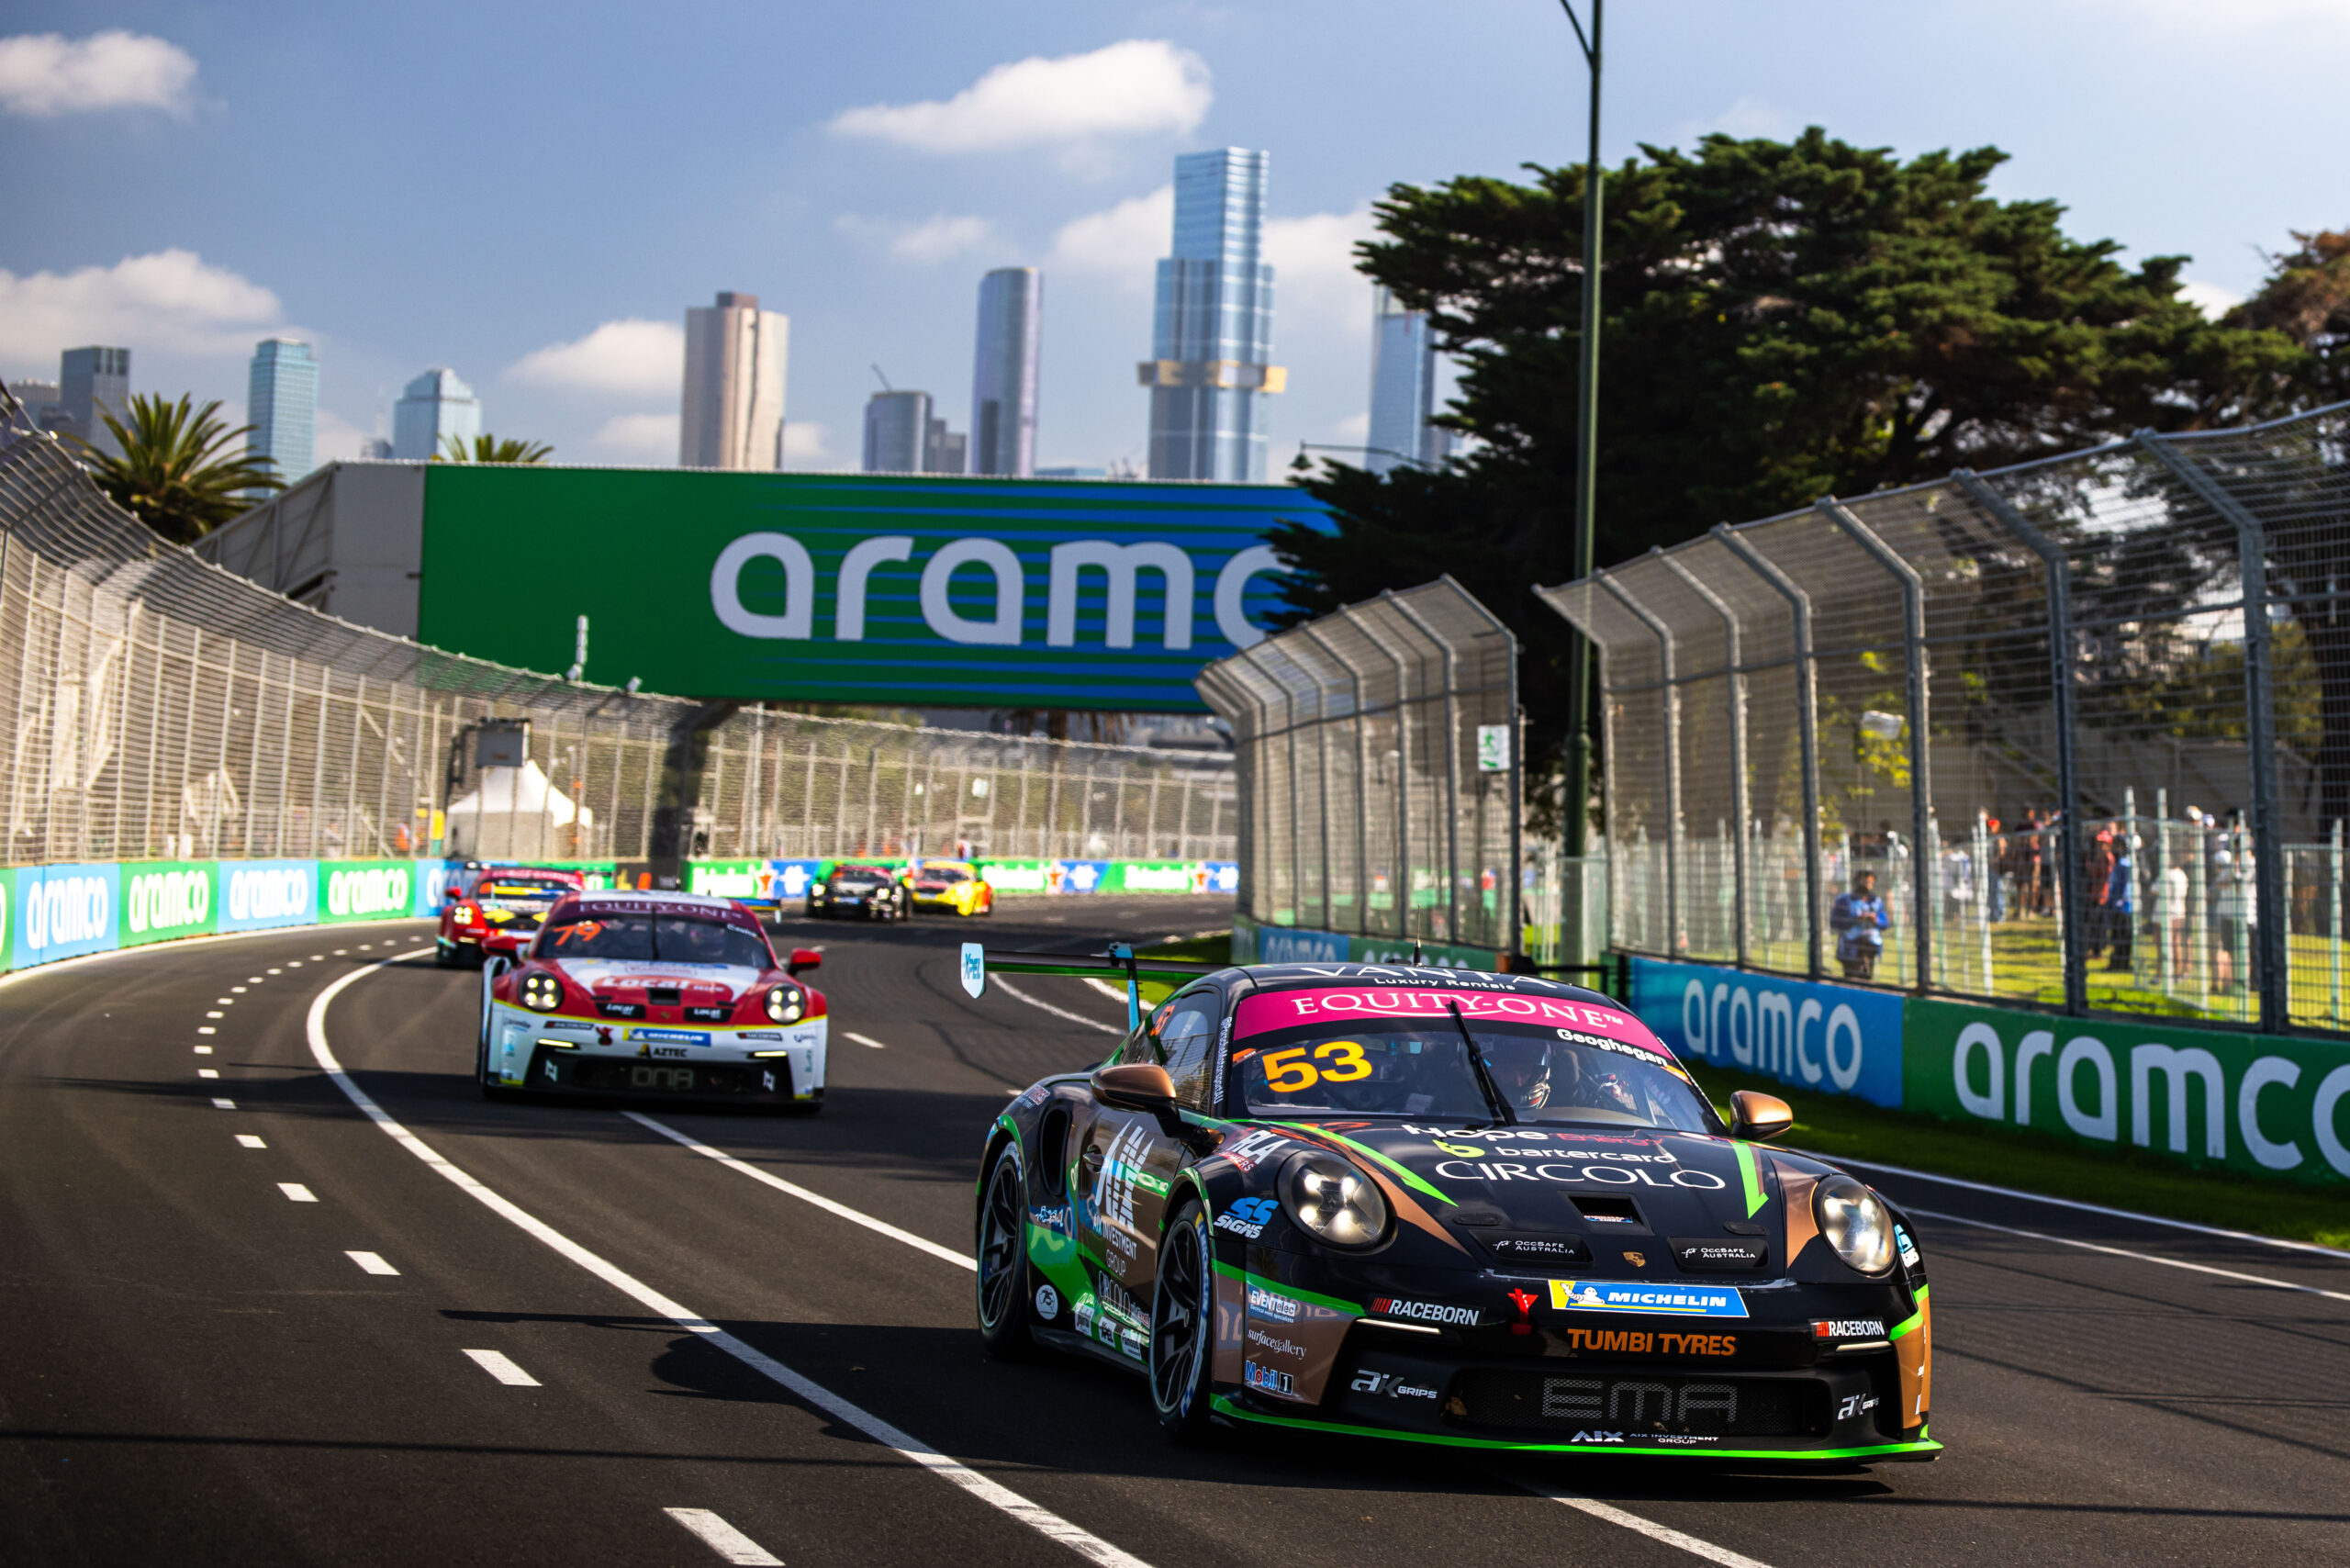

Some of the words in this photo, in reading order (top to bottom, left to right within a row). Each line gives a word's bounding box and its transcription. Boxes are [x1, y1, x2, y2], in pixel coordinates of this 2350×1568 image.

[710, 531, 1294, 651] aramc
[129, 869, 209, 934] aramco
[229, 868, 308, 920] aramco
[328, 868, 408, 915] aramco
[27, 876, 108, 949] aramco
[553, 922, 601, 946] 79
[1300, 966, 1558, 989] VANTA
[1374, 978, 1438, 988] Luxury
[1446, 979, 1516, 991] Rentals
[1557, 1028, 1668, 1067] Geoghegan
[1682, 979, 1863, 1091] aramco
[653, 1047, 688, 1058] AZTEC
[1262, 1041, 1372, 1092] 53
[1402, 1125, 1549, 1141] Hope
[1495, 1146, 1677, 1163] bartercard
[1435, 1160, 1726, 1190] CIRCOLO
[1225, 1196, 1280, 1226] SS
[1102, 1221, 1137, 1260] INVESTMENT
[1214, 1215, 1263, 1239] SIGNS
[1106, 1249, 1126, 1277] GROUP
[1388, 1299, 1480, 1327] RACEBORN
[1608, 1291, 1727, 1307] MICHELIN
[1567, 1328, 1652, 1352] TUMBI
[1658, 1332, 1738, 1356] TYRES
[1828, 1320, 1886, 1338] RACEBORN
[1248, 1328, 1307, 1361] surfacegallery
[1246, 1360, 1278, 1391] Mobil
[1397, 1385, 1438, 1399] GRIPS
[1541, 1378, 1739, 1422] EMA
[1571, 1429, 1625, 1442] AIX
